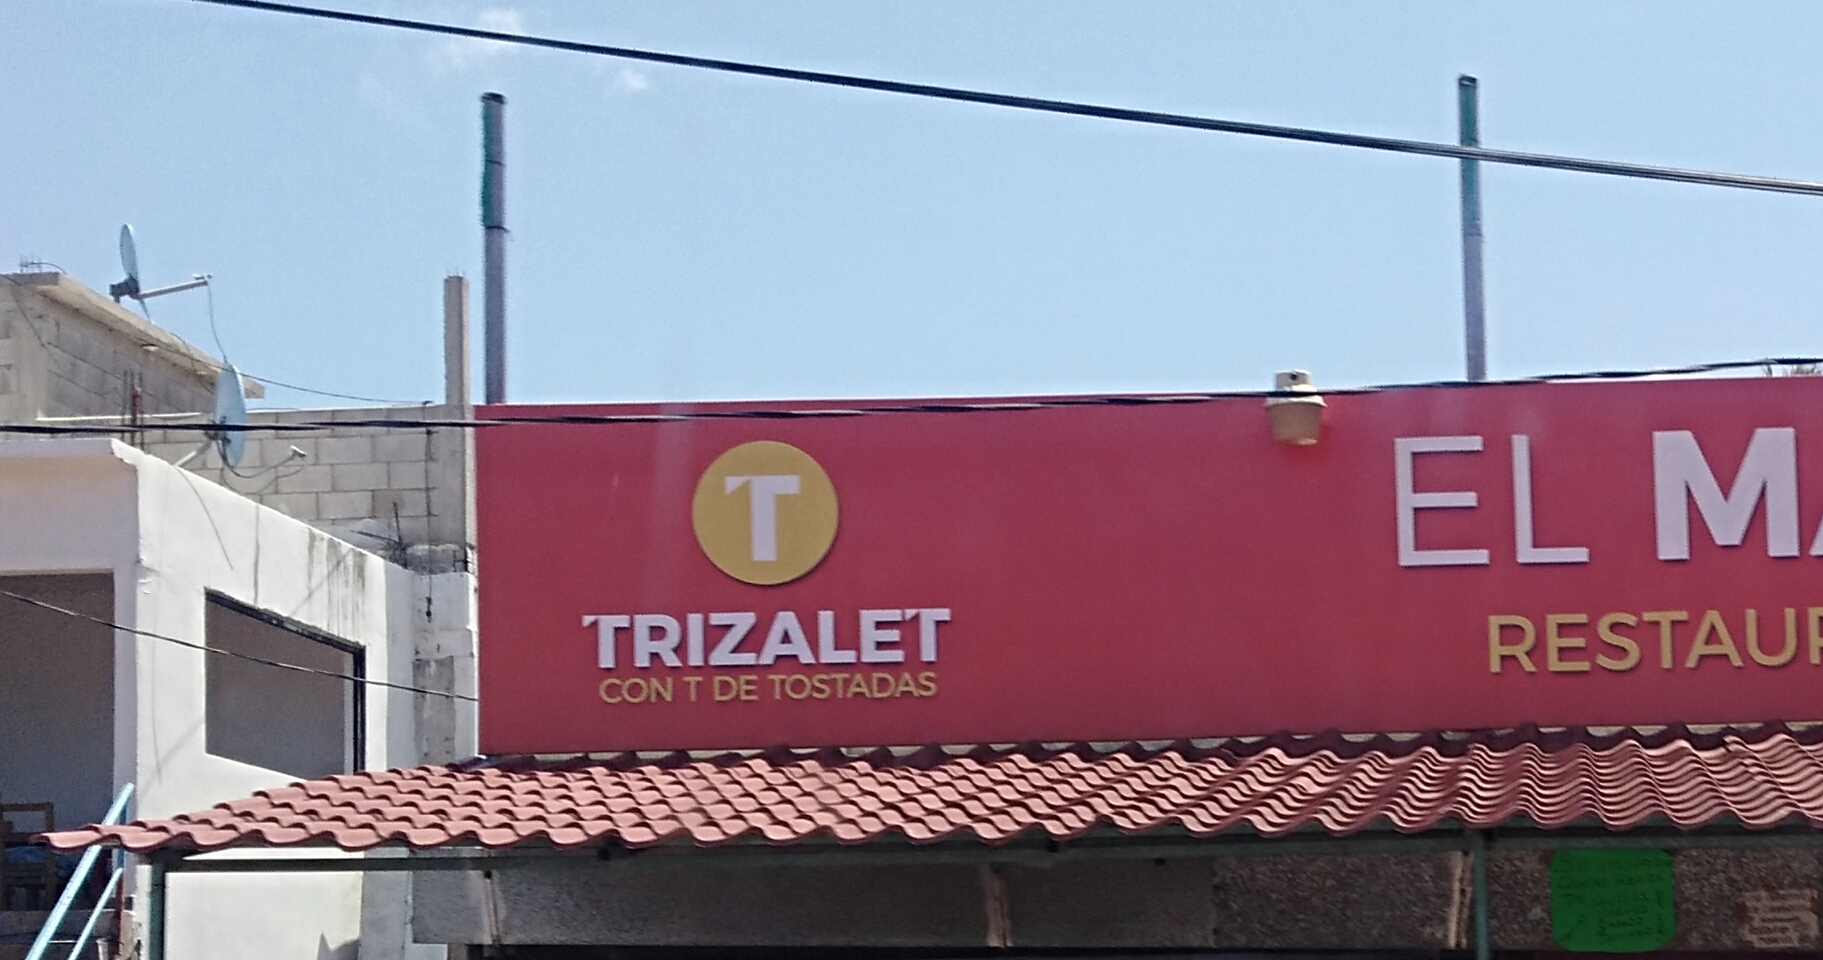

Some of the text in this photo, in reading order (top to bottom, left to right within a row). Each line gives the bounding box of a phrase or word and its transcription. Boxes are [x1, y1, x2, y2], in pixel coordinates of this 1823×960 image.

[724, 475, 801, 562] T
[1394, 434, 1590, 566] EL
[582, 607, 953, 669] TRIZALET
[599, 670, 939, 705] CON T DE TOSTADAS
